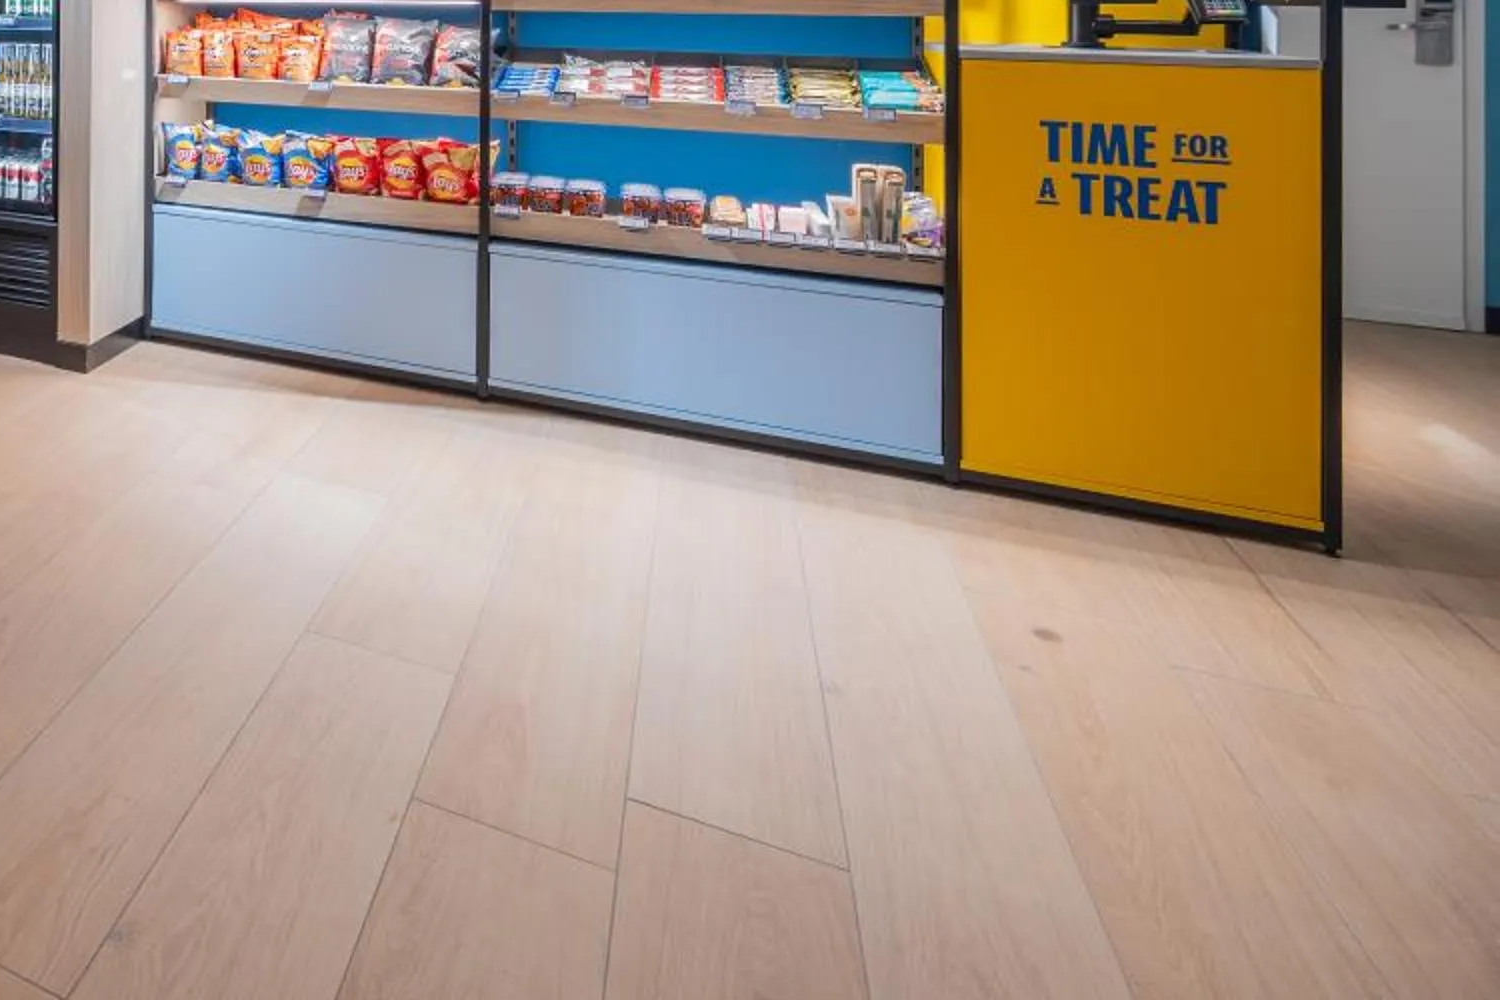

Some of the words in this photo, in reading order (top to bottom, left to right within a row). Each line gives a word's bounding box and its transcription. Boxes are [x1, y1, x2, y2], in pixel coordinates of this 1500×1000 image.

[1039, 120, 1157, 168] TIME
[1173, 133, 1229, 160] FOR
[1039, 176, 1057, 199] A
[1071, 172, 1227, 225] TREAT
